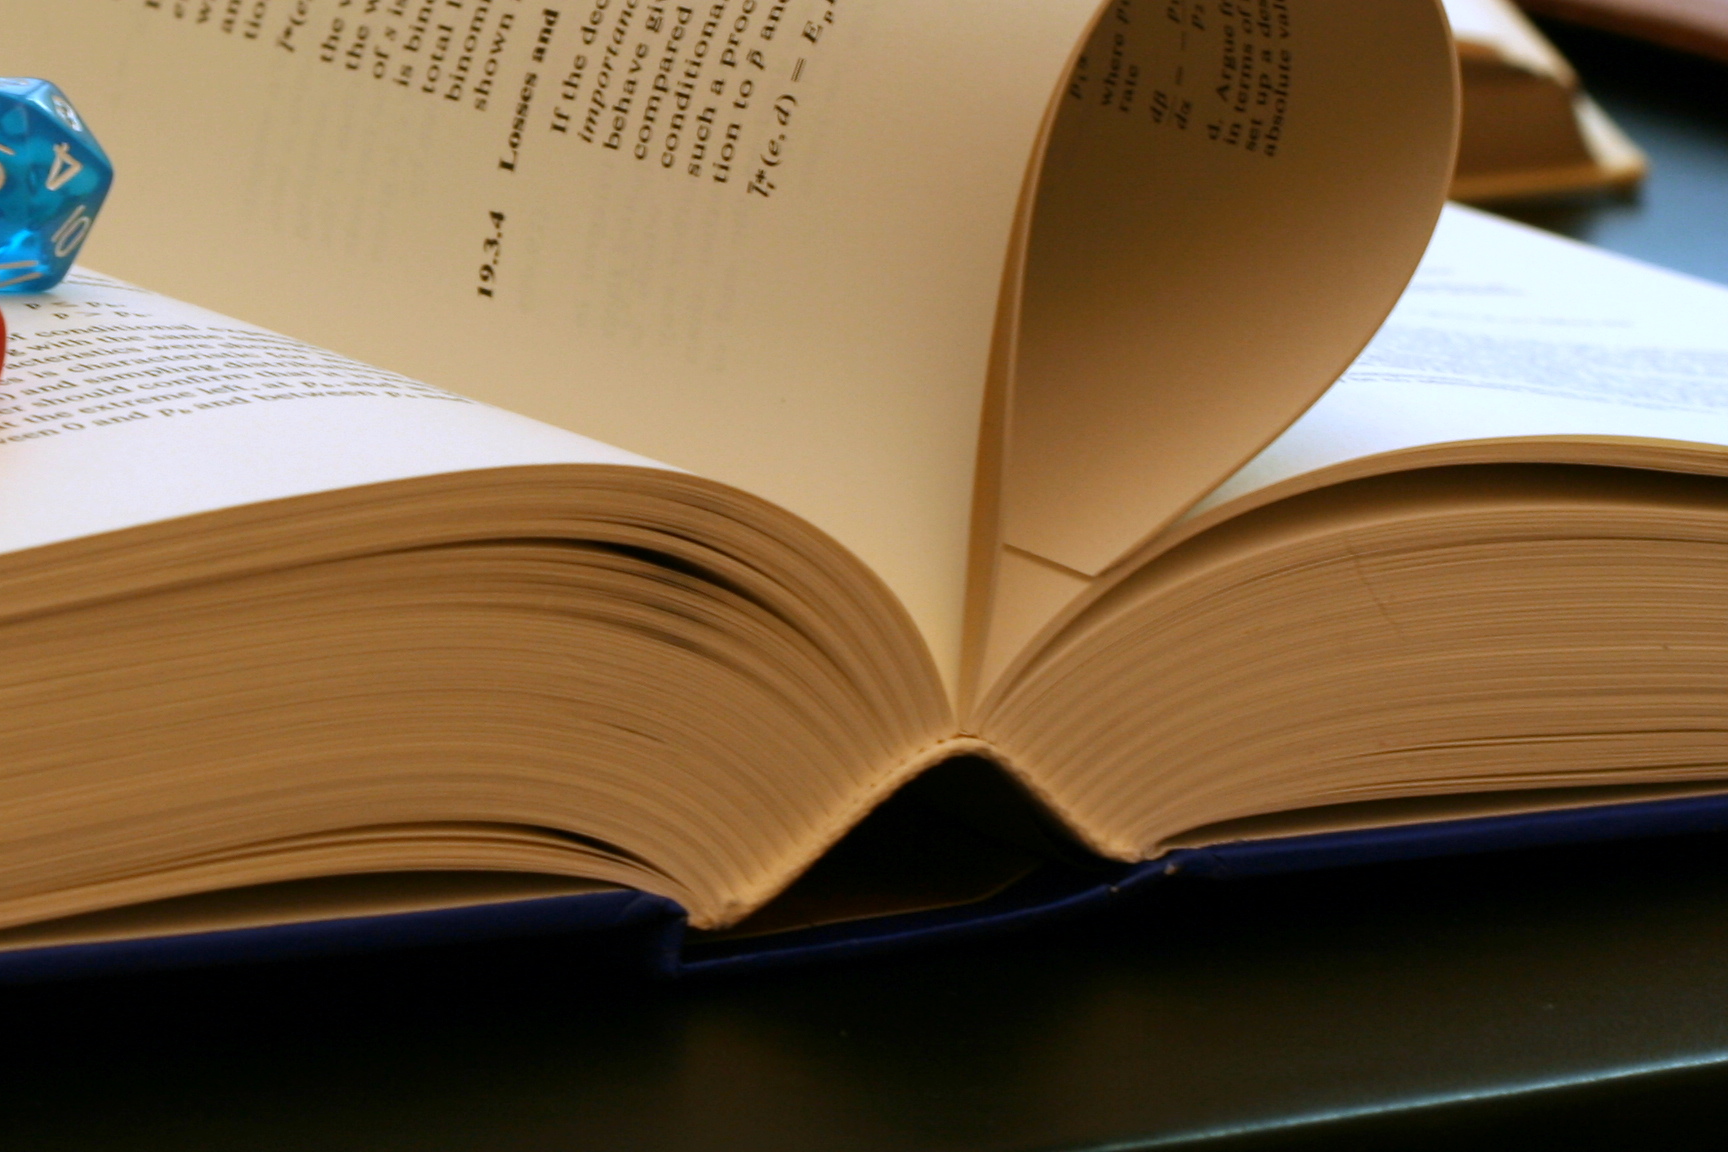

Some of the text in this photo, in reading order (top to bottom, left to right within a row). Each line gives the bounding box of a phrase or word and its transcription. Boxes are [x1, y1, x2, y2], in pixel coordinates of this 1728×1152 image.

[344, 24, 370, 71] the
[372, 46, 390, 81] of
[392, 63, 415, 88] is
[421, 23, 454, 94] total
[473, 12, 515, 112] shown
[634, 4, 694, 162] compared
[1101, 32, 1140, 114] where rate
[1215, 24, 1240, 102] Argue
[550, 106, 570, 134] If
[561, 53, 588, 102] the
[602, 42, 649, 151] behave
[1223, 43, 1254, 146] in terms
[1245, 118, 1263, 152] set
[1256, 73, 1275, 106] up
[1264, 48, 1293, 158] absolute
[45, 143, 84, 191] 4
[477, 210, 506, 299] 19.3.4
[498, 72, 538, 174] Losses
[531, 8, 560, 64] and
[688, 106, 717, 178] such
[712, 122, 742, 184] tion
[20, 362, 223, 396] and sampling
[23, 409, 73, 425] the
[78, 389, 197, 415] extreme
[30, 369, 251, 408] should confirm
[91, 411, 150, 428] and
